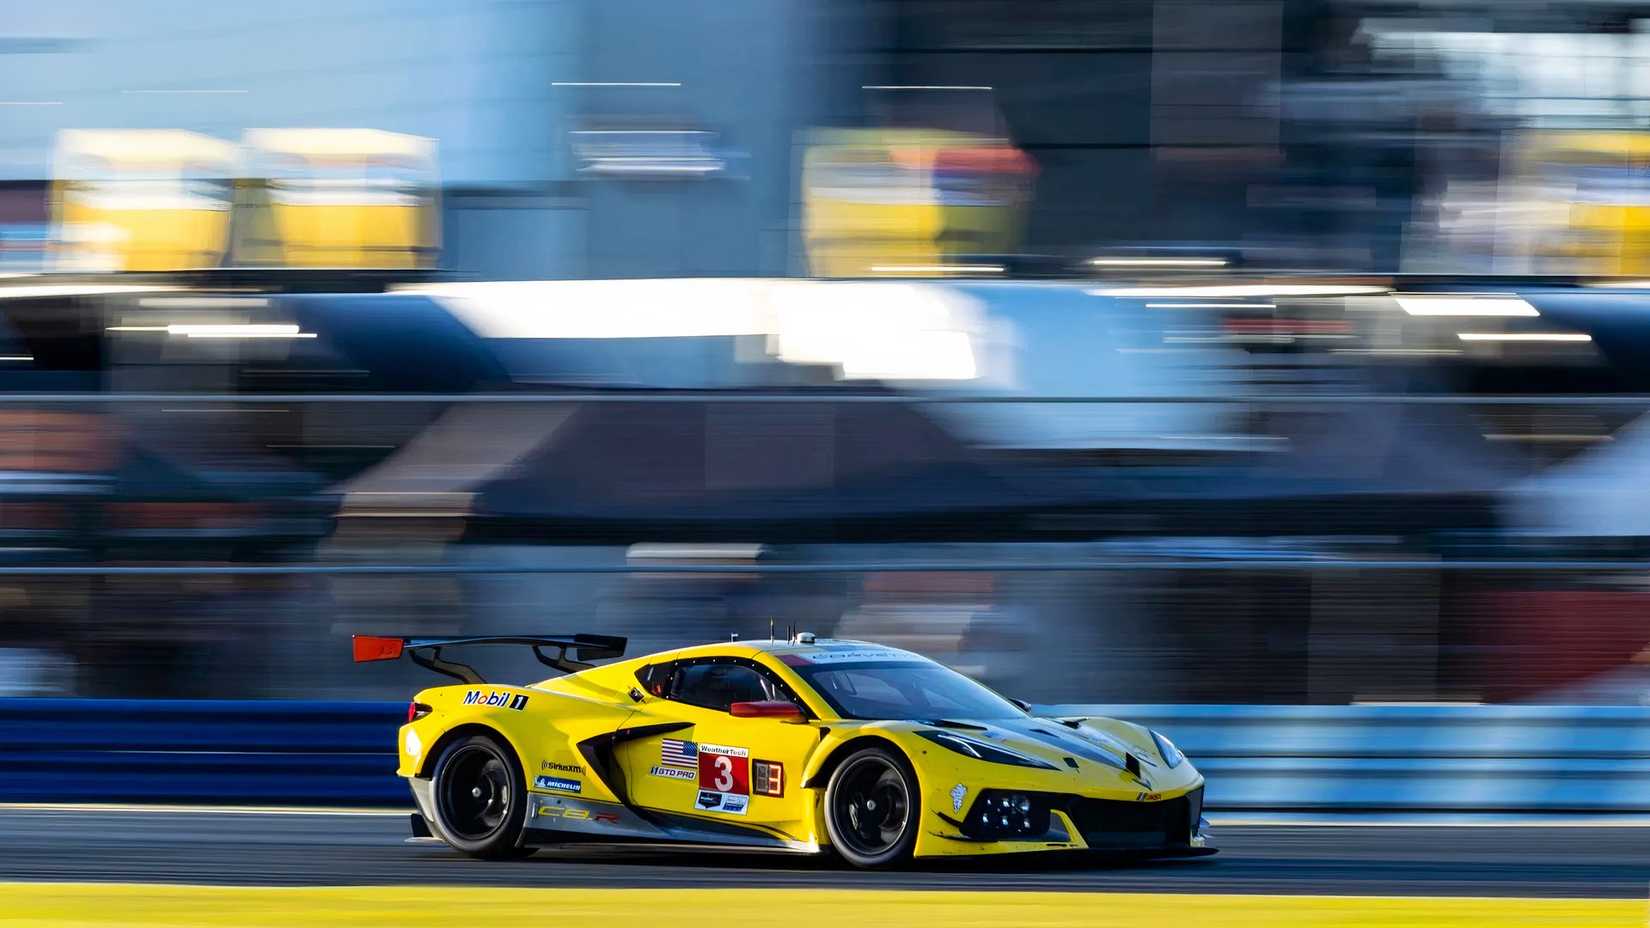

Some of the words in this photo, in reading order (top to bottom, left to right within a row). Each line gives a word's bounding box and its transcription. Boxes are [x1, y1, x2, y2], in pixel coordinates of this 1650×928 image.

[463, 690, 511, 707] Mobil
[701, 745, 747, 756] WeatherTech
[659, 768, 676, 776] GTD
[676, 770, 695, 779] PRO
[714, 756, 734, 792] 3
[547, 781, 581, 791] MICHELIN
